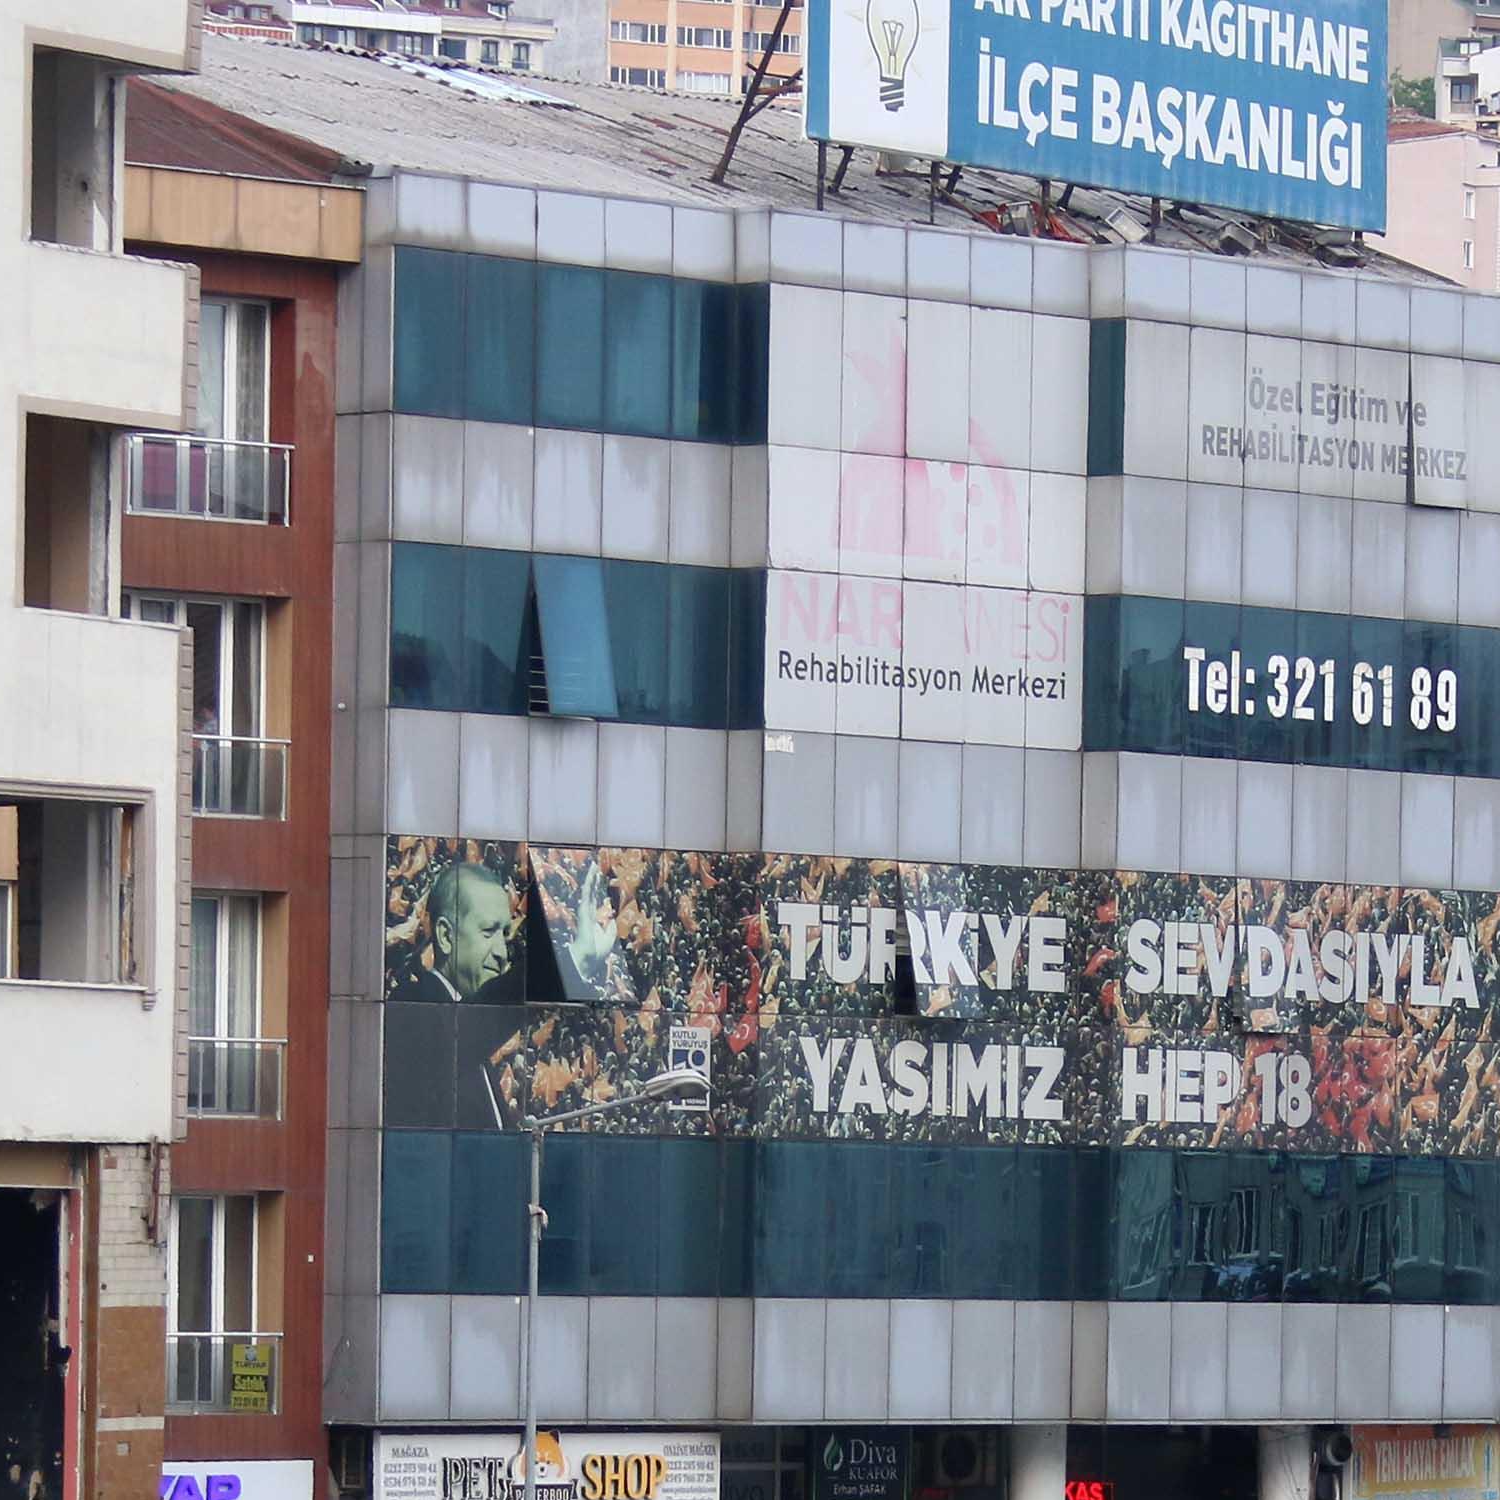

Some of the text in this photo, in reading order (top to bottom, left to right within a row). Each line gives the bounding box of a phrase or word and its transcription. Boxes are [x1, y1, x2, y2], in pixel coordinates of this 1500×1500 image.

[978, 37, 1362, 189] İLÇE BAŞKANLIĞI
[1250, 367, 1426, 426] Özel Eğitim ve
[1202, 424, 1467, 480] REHABİLİTASYON MERKEZ
[779, 650, 1066, 699] Rehabilitasyon Merkezi
[1183, 646, 1457, 732] Tel: 321 61 89
[1125, 919, 1480, 1009] SEVDASIYLA
[1123, 1047, 1245, 1124] HEP
[1255, 1052, 1312, 1128] 18
[850, 1439, 897, 1464] Diva
